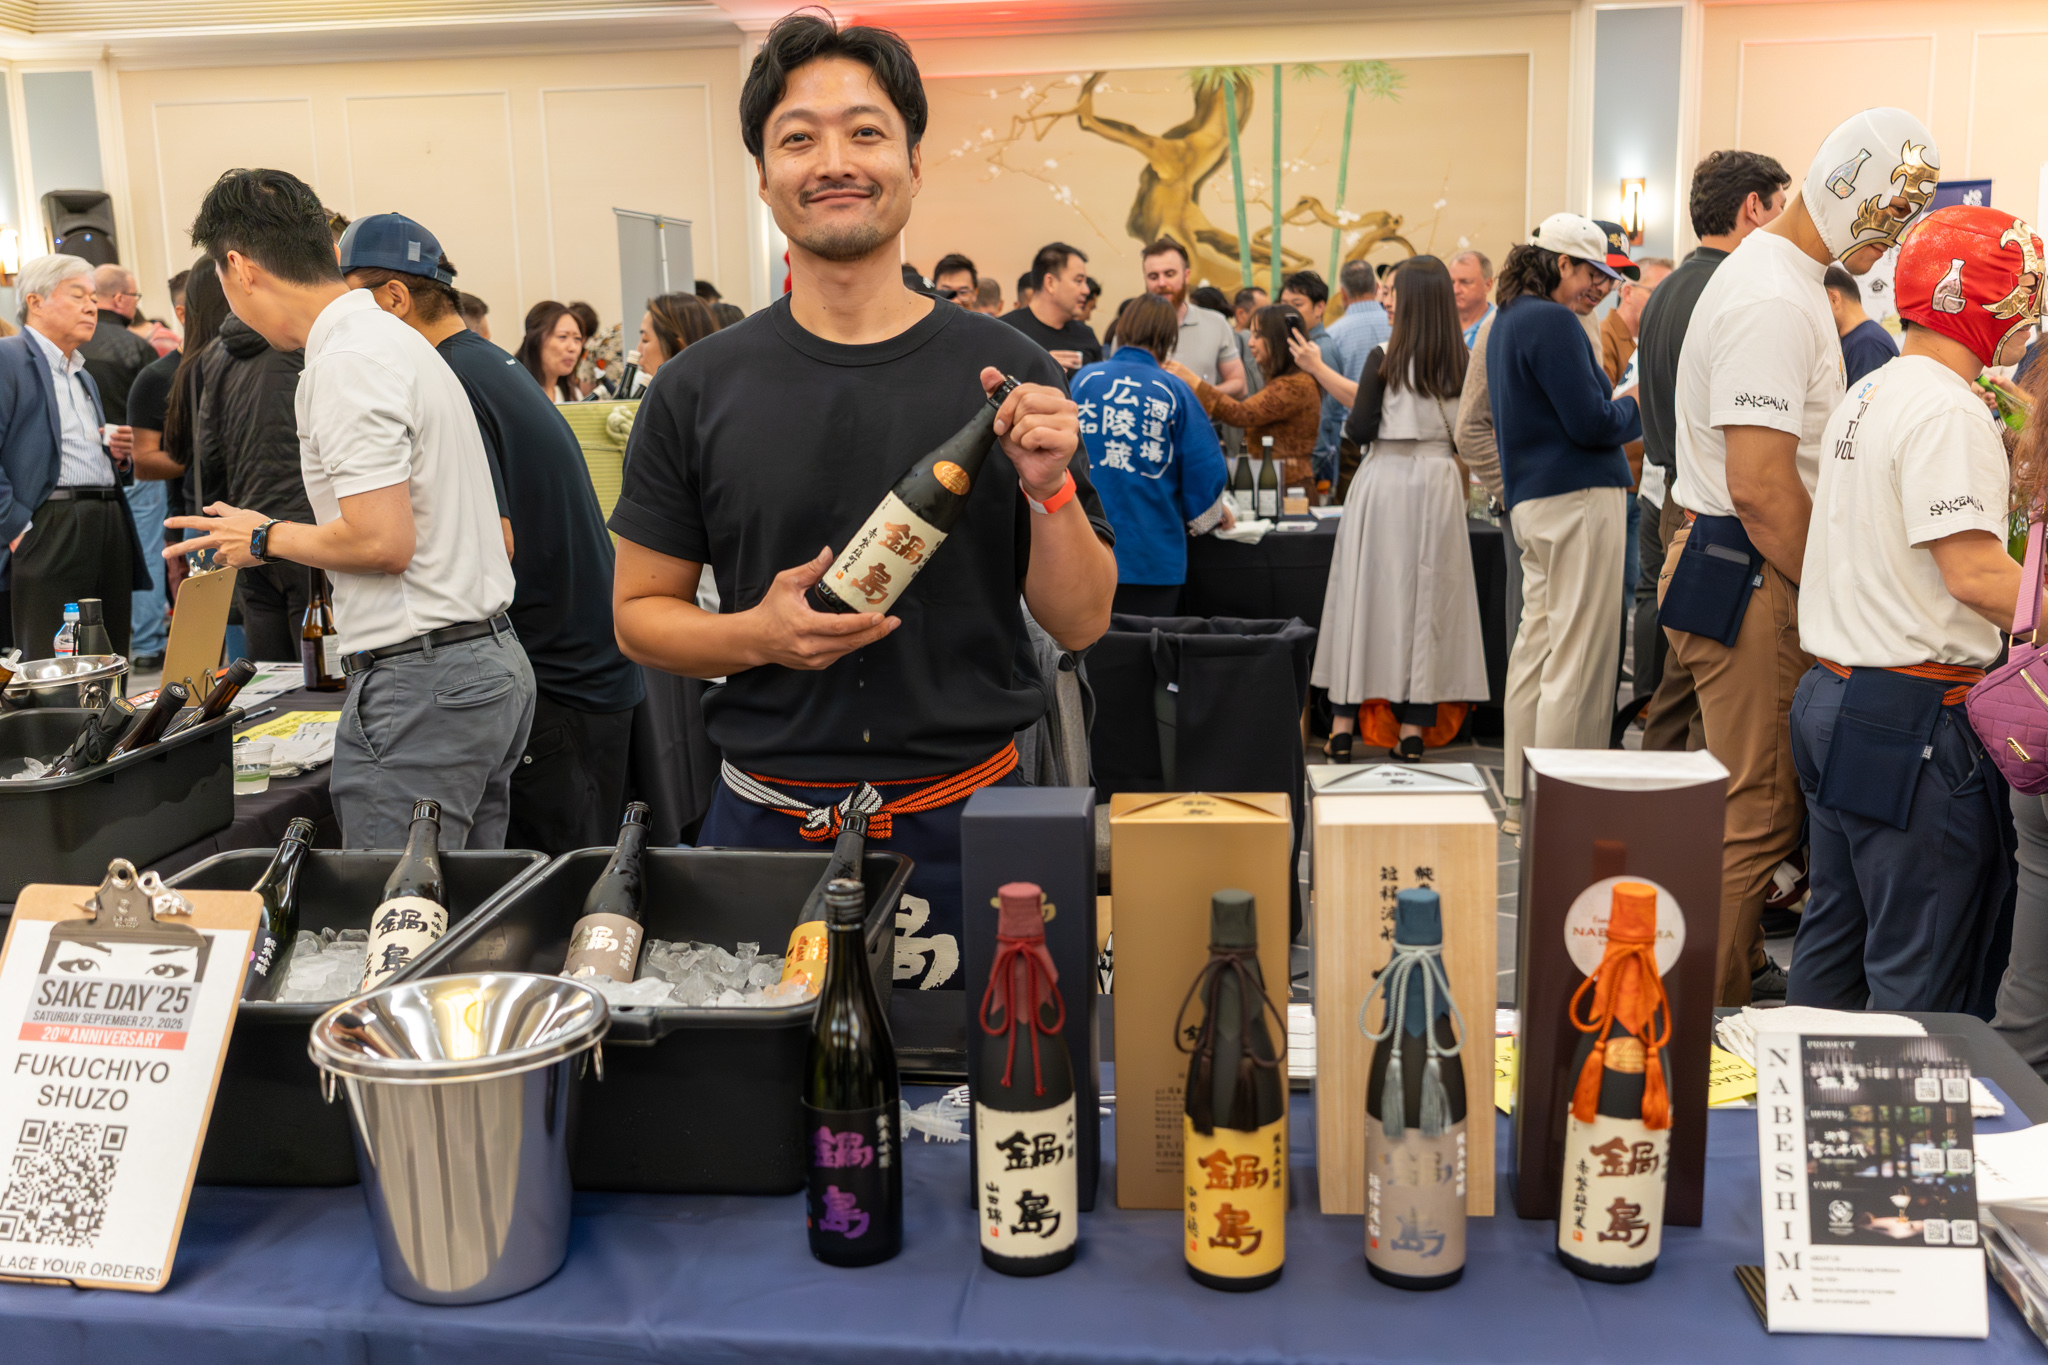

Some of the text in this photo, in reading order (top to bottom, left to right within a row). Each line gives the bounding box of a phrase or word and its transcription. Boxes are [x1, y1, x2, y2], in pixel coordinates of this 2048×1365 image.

[1099, 375, 1142, 473] 広陵蔵
[1139, 396, 1170, 463] 酒道場
[850, 521, 926, 605] 鍋島
[32, 1010, 184, 1029] SATURDAY SEPTEMBER 27, 2025
[37, 979, 103, 1009] SAKE
[14, 1052, 170, 1084] FUKUCHIYO
[41, 1026, 164, 1048] 20TH ANNIVERSARY
[37, 1084, 129, 1111] SHUZO
[813, 1125, 874, 1239] 鍋島
[995, 1129, 1064, 1239] 鍋島
[1197, 1148, 1269, 1256] 鍋島
[1589, 1136, 1660, 1248] 鍋島
[1767, 1048, 1803, 1301] NABESHIMA
[42, 1258, 87, 1275] YOUR
[90, 1262, 162, 1282] ORDERS!
